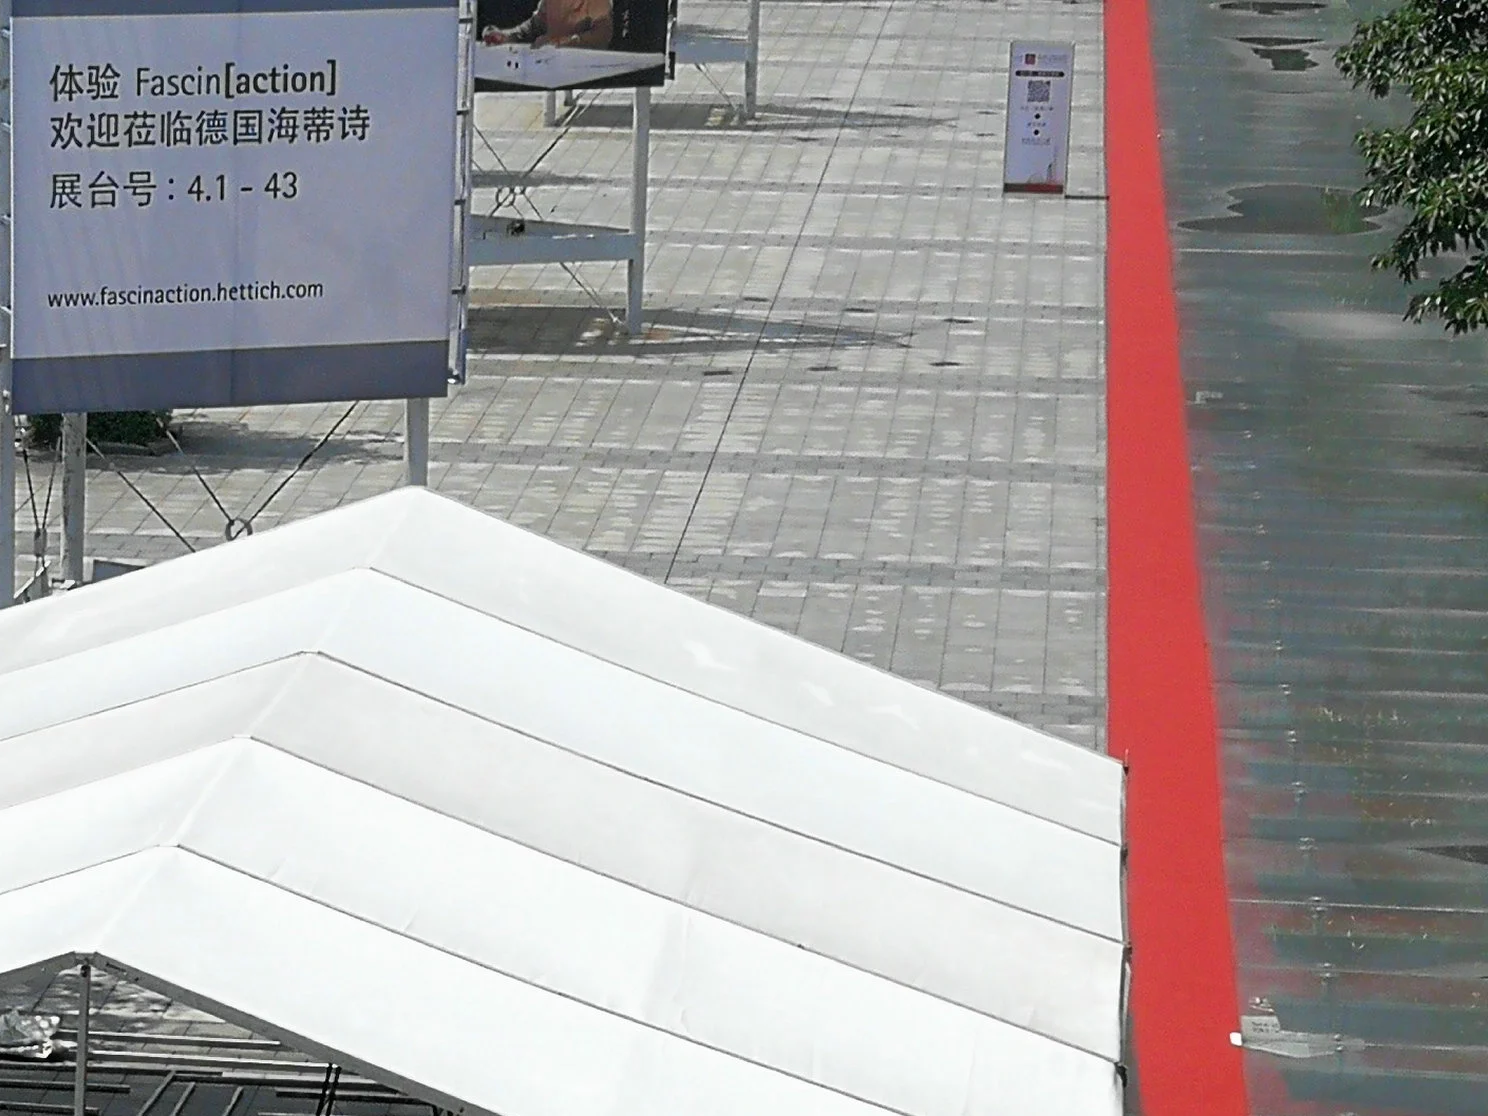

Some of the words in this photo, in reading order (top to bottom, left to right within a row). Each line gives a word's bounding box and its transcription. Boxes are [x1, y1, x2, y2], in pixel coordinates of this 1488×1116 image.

[49, 63, 121, 102] 体验
[136, 59, 337, 97] Fascin[action]
[50, 104, 369, 150] 欢迎莅临德国海蒂诗
[47, 281, 323, 307] www.fascinaction.hettich.com
